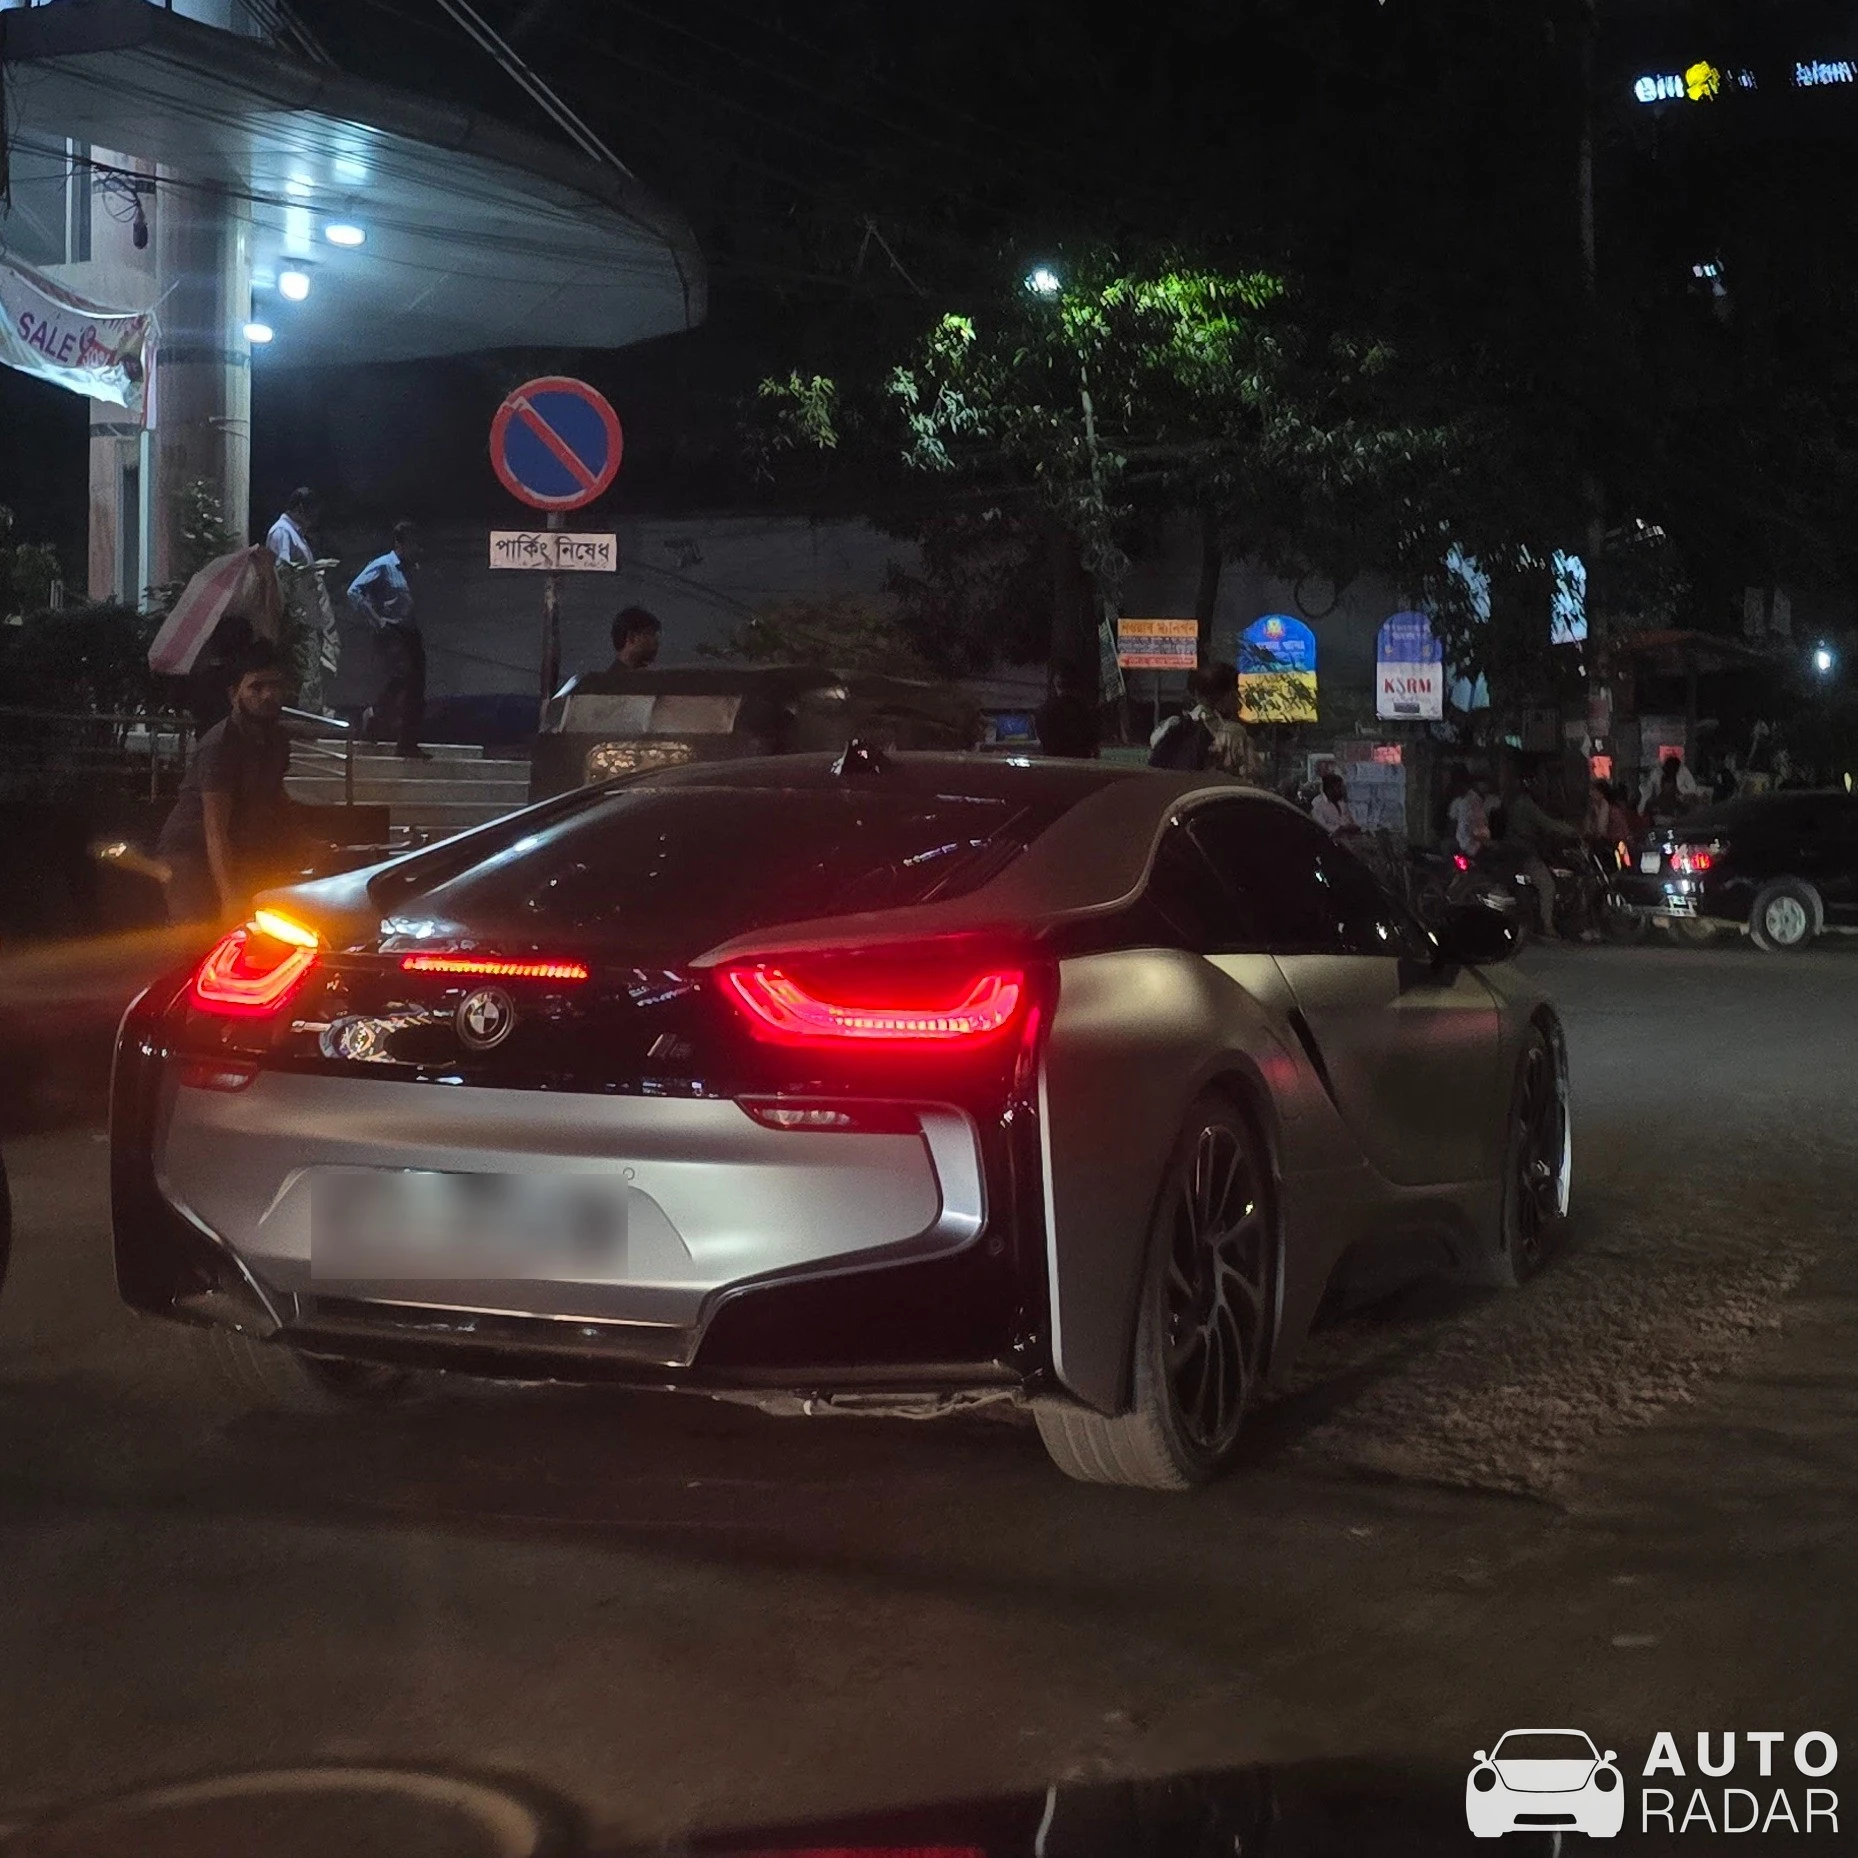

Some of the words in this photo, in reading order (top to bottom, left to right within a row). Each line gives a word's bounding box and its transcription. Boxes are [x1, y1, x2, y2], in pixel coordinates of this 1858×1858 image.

[17, 312, 76, 362] SALE
[495, 534, 552, 563] পার্কিং
[554, 536, 610, 563] নিষেধ
